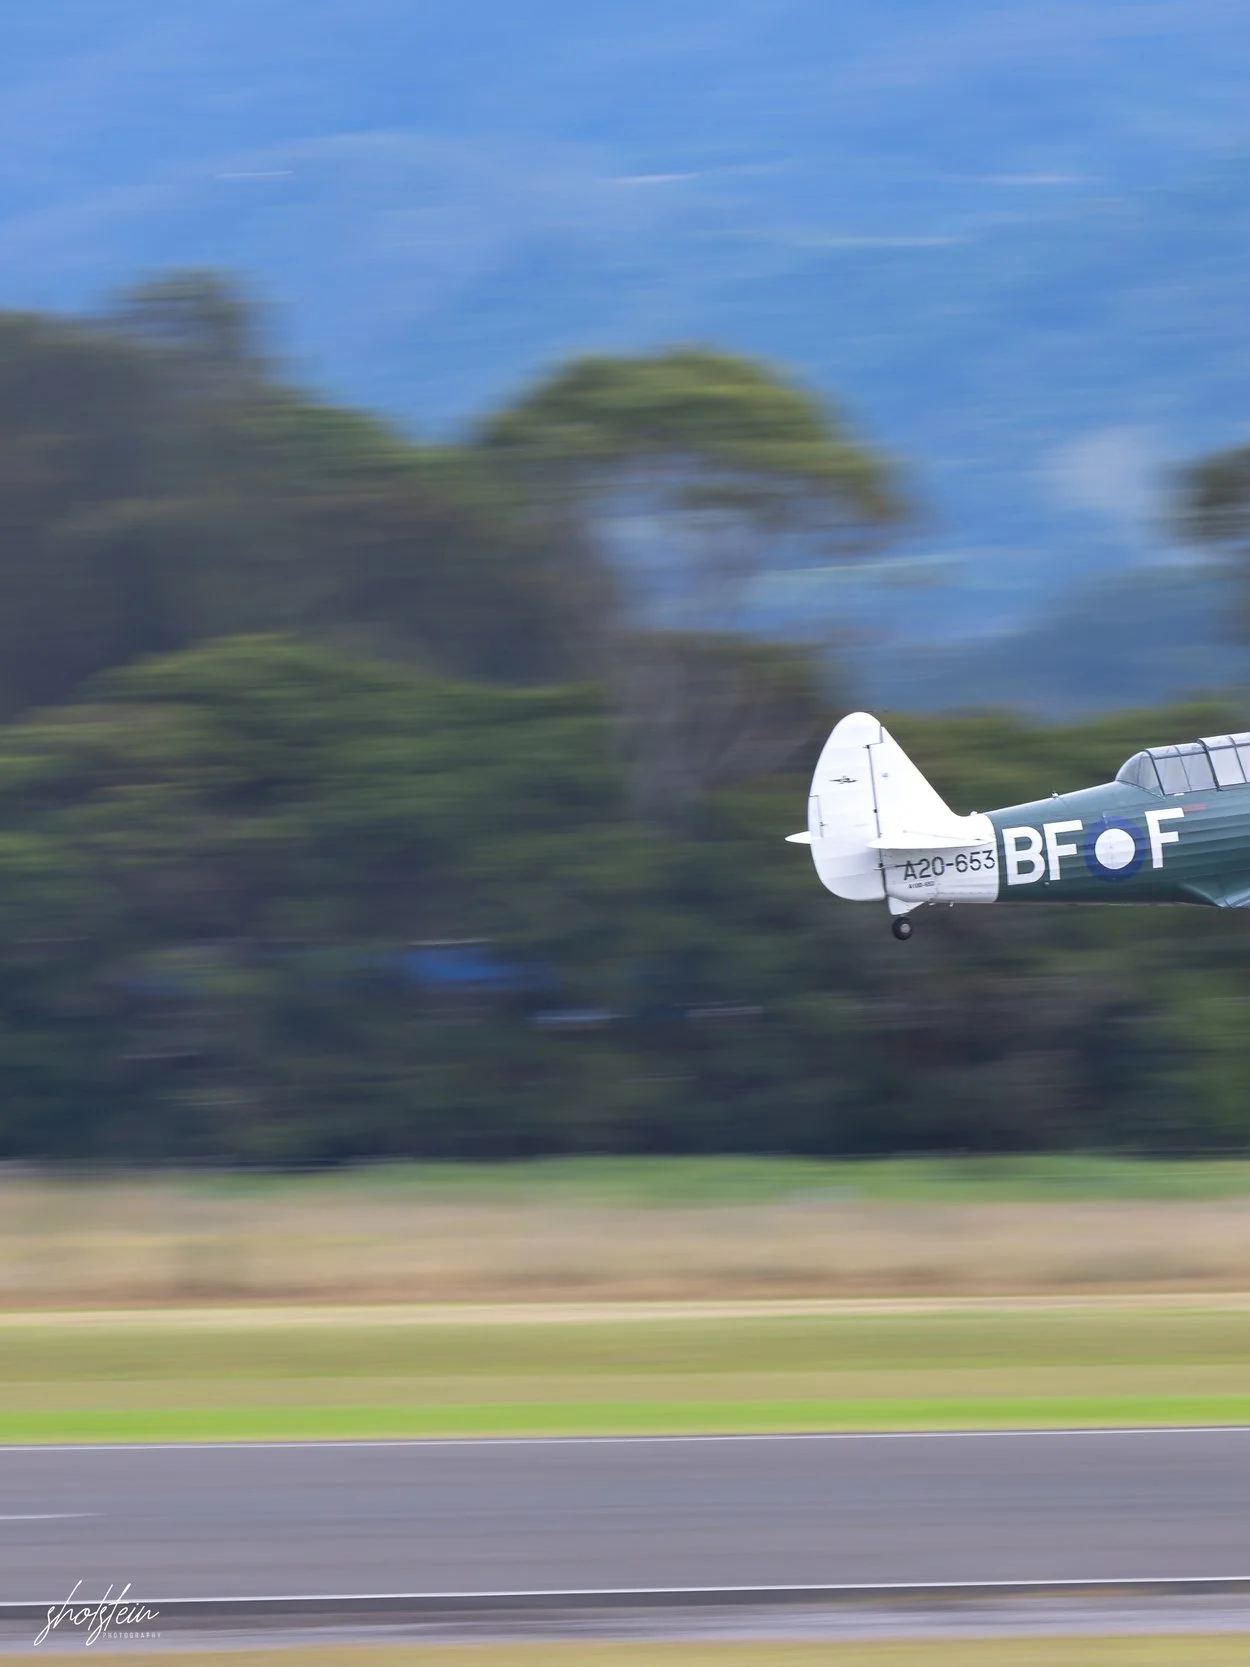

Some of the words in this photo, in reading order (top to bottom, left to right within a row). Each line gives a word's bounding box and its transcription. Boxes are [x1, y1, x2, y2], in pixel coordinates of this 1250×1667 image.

[903, 849, 996, 881] A20-653
[1002, 819, 1084, 886] BF
[1144, 807, 1185, 869] F
